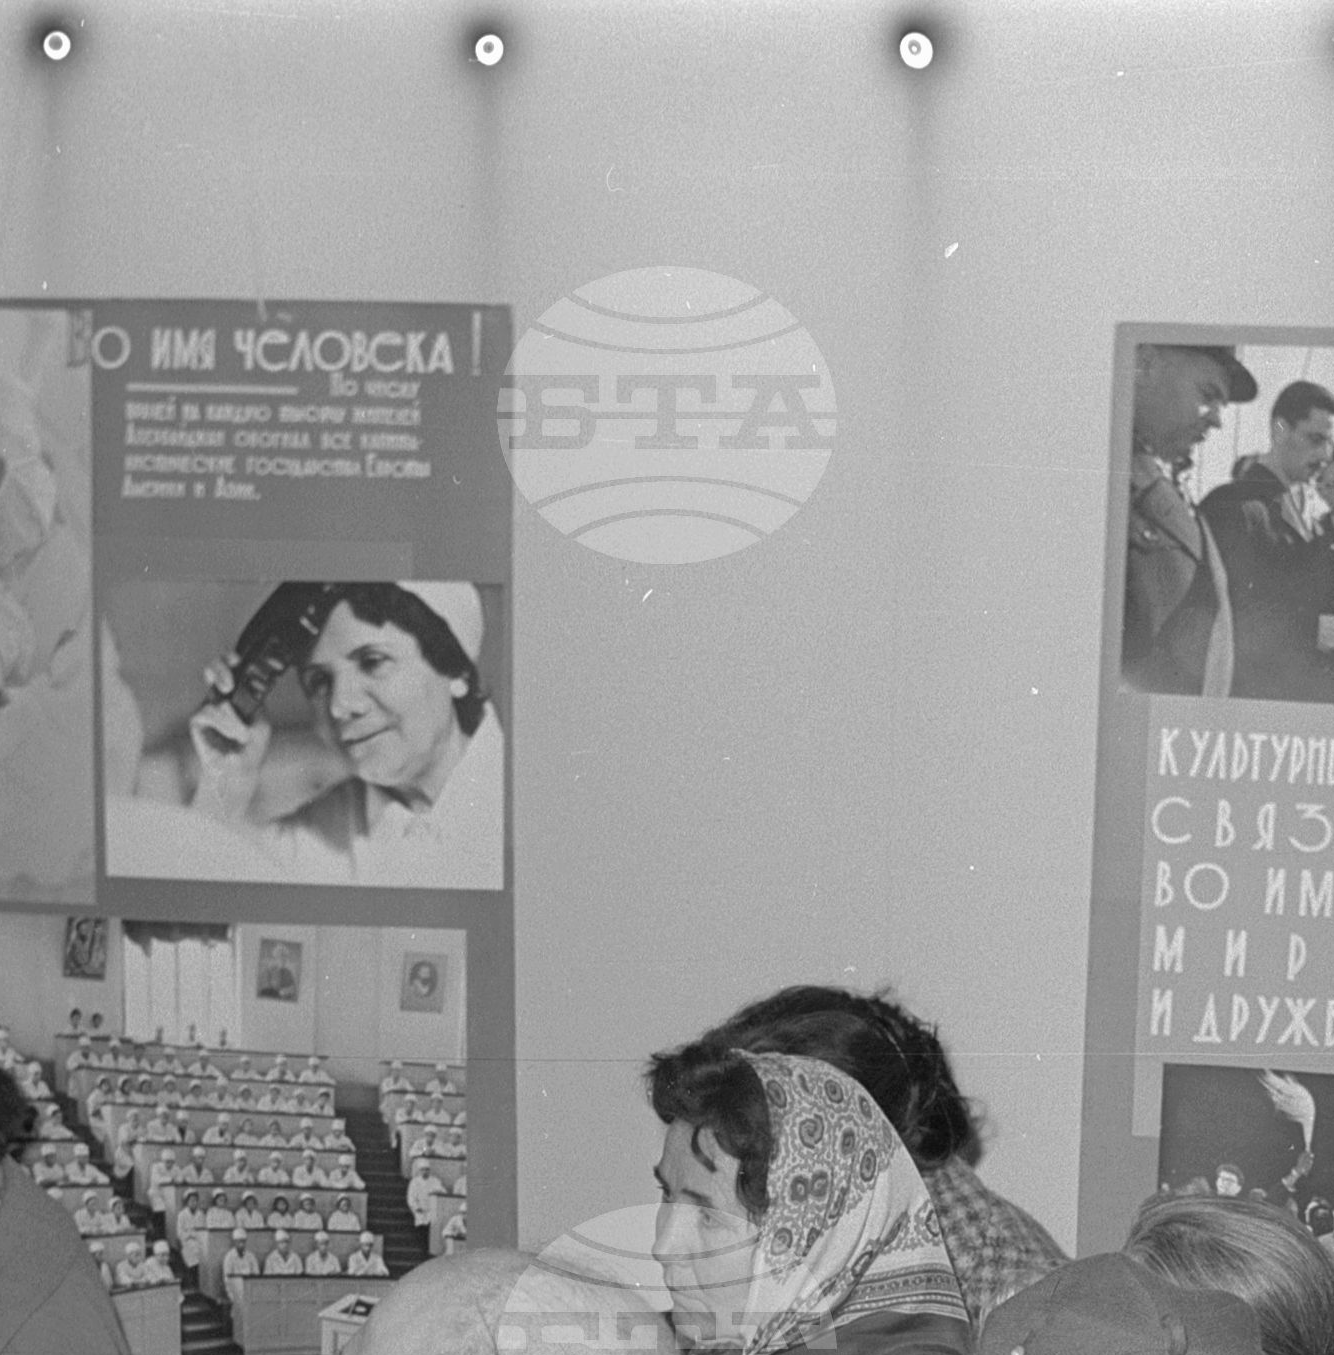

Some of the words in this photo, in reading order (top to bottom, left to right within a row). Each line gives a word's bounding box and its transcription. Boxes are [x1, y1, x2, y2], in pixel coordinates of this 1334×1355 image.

[151, 327, 216, 371] ИМЯ
[1154, 860, 1230, 911] ВО
[1150, 987, 1173, 1037] И
